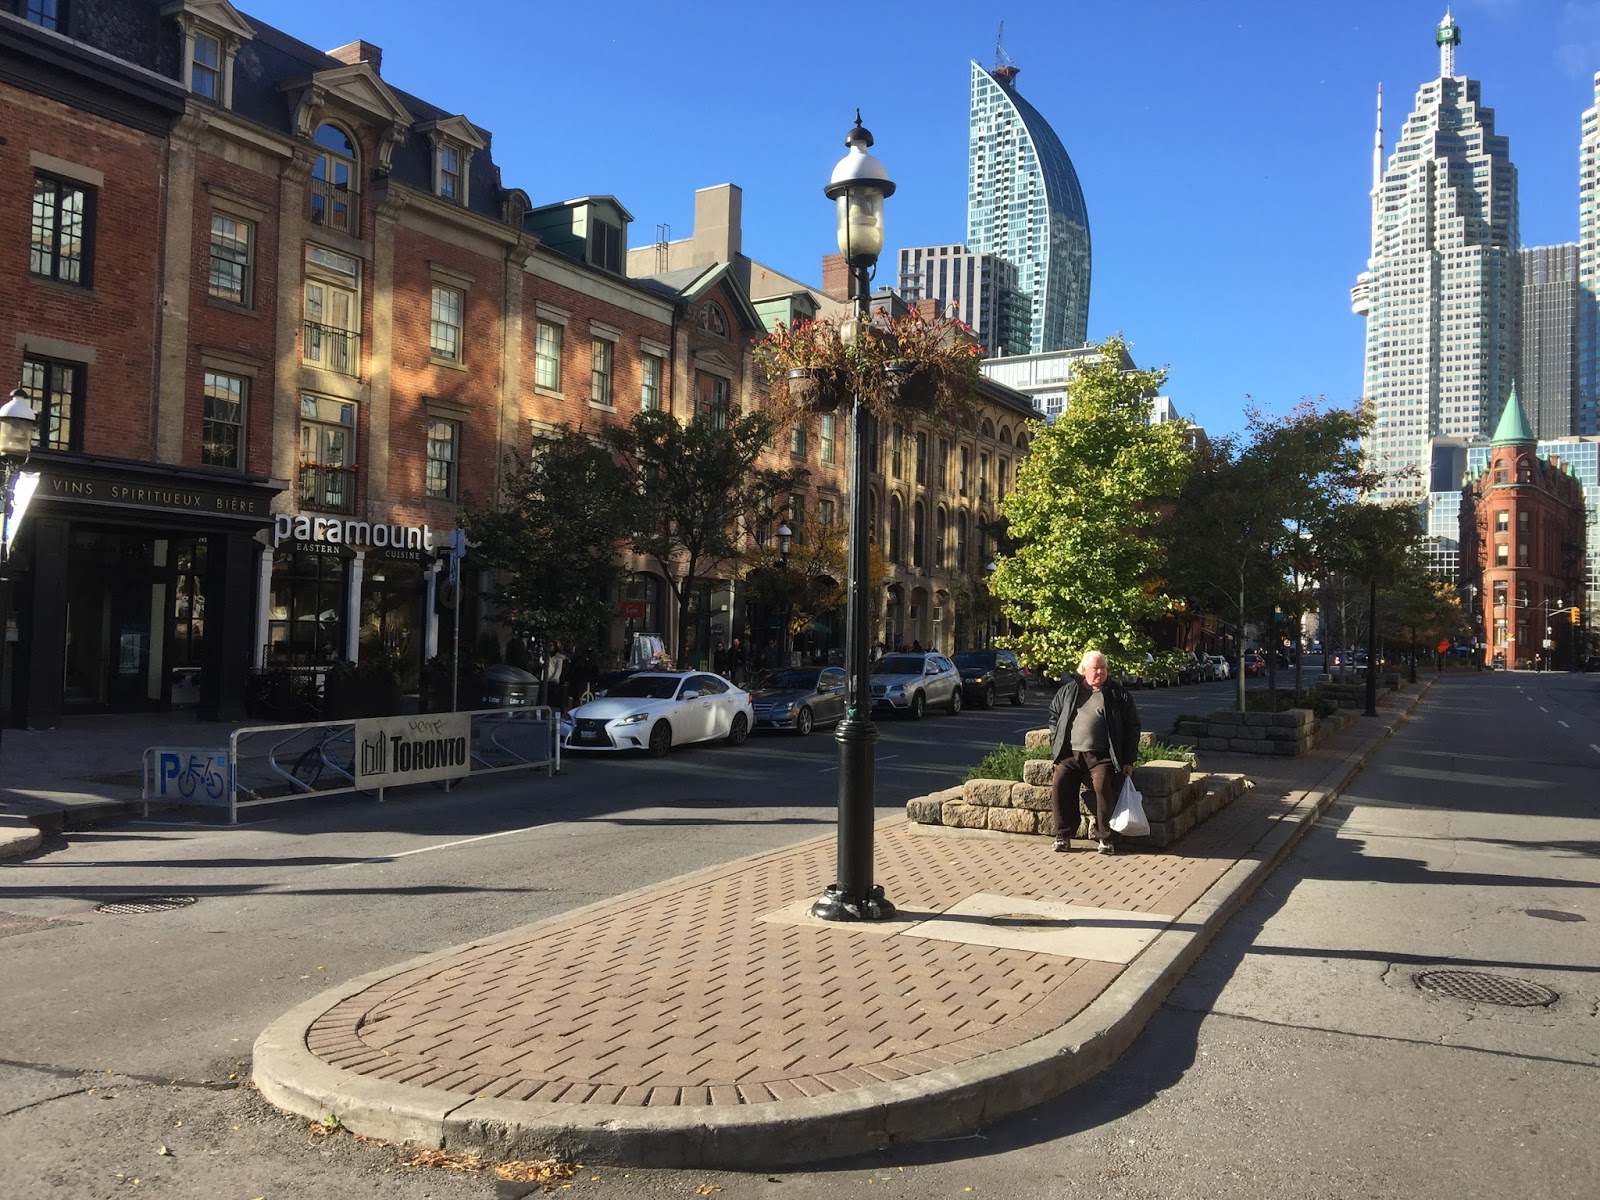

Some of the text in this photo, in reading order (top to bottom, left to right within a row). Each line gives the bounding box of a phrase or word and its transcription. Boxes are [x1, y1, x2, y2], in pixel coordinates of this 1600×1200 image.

[1440, 28, 1453, 38] TD
[53, 480, 255, 513] VINS SPIRITUEUX BIÈRE
[274, 513, 434, 551] paramount
[296, 543, 340, 554] EASTERN
[385, 550, 420, 560] CUISINE
[160, 753, 180, 795] P
